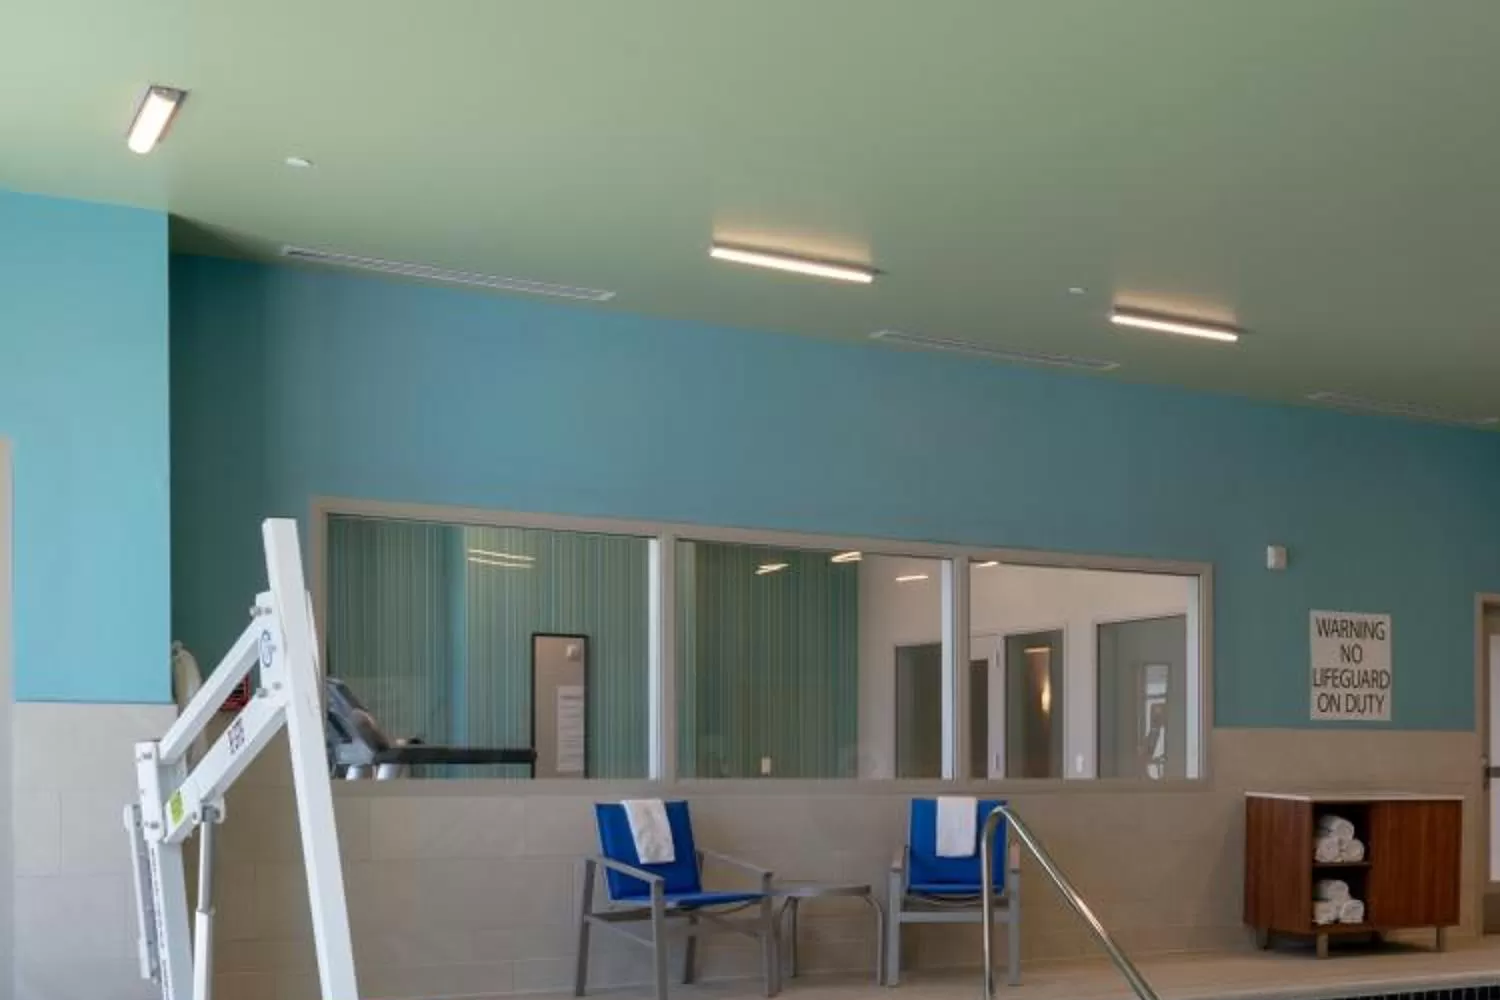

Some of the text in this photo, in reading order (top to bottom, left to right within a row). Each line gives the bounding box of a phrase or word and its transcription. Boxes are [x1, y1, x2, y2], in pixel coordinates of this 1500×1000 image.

[1315, 617, 1385, 641] WARNING
[1340, 643, 1363, 664] NO
[1312, 667, 1391, 689] LIFEGUARD
[1317, 692, 1385, 714] ON DUTY
